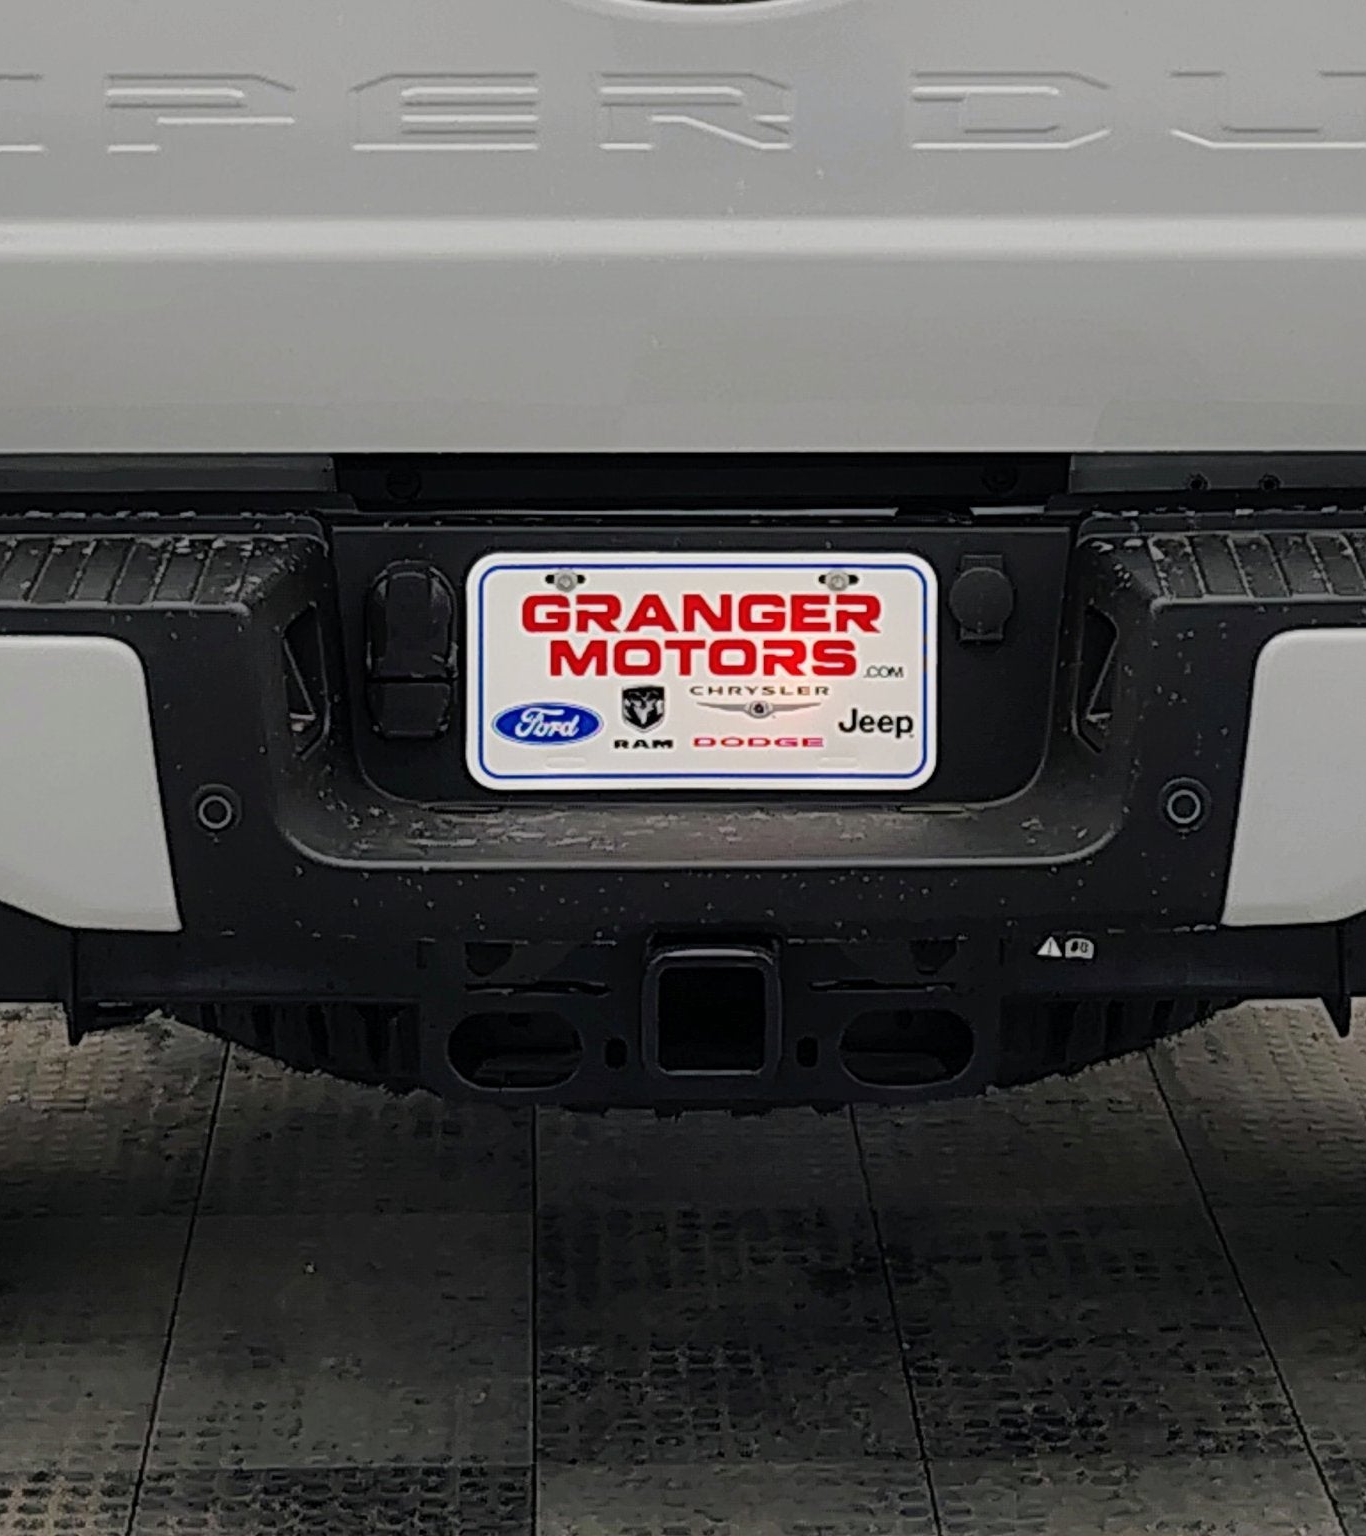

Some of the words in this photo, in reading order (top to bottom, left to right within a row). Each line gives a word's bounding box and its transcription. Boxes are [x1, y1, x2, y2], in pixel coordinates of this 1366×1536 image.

[521, 594, 881, 633] GRANGER
[549, 639, 857, 677] MOTORS
[863, 665, 904, 678] .COM
[689, 685, 830, 696] CHRYSLER
[514, 707, 580, 738] Ford
[838, 708, 914, 739] Jeep
[614, 739, 674, 749] RAM
[693, 737, 824, 748] DODGE
